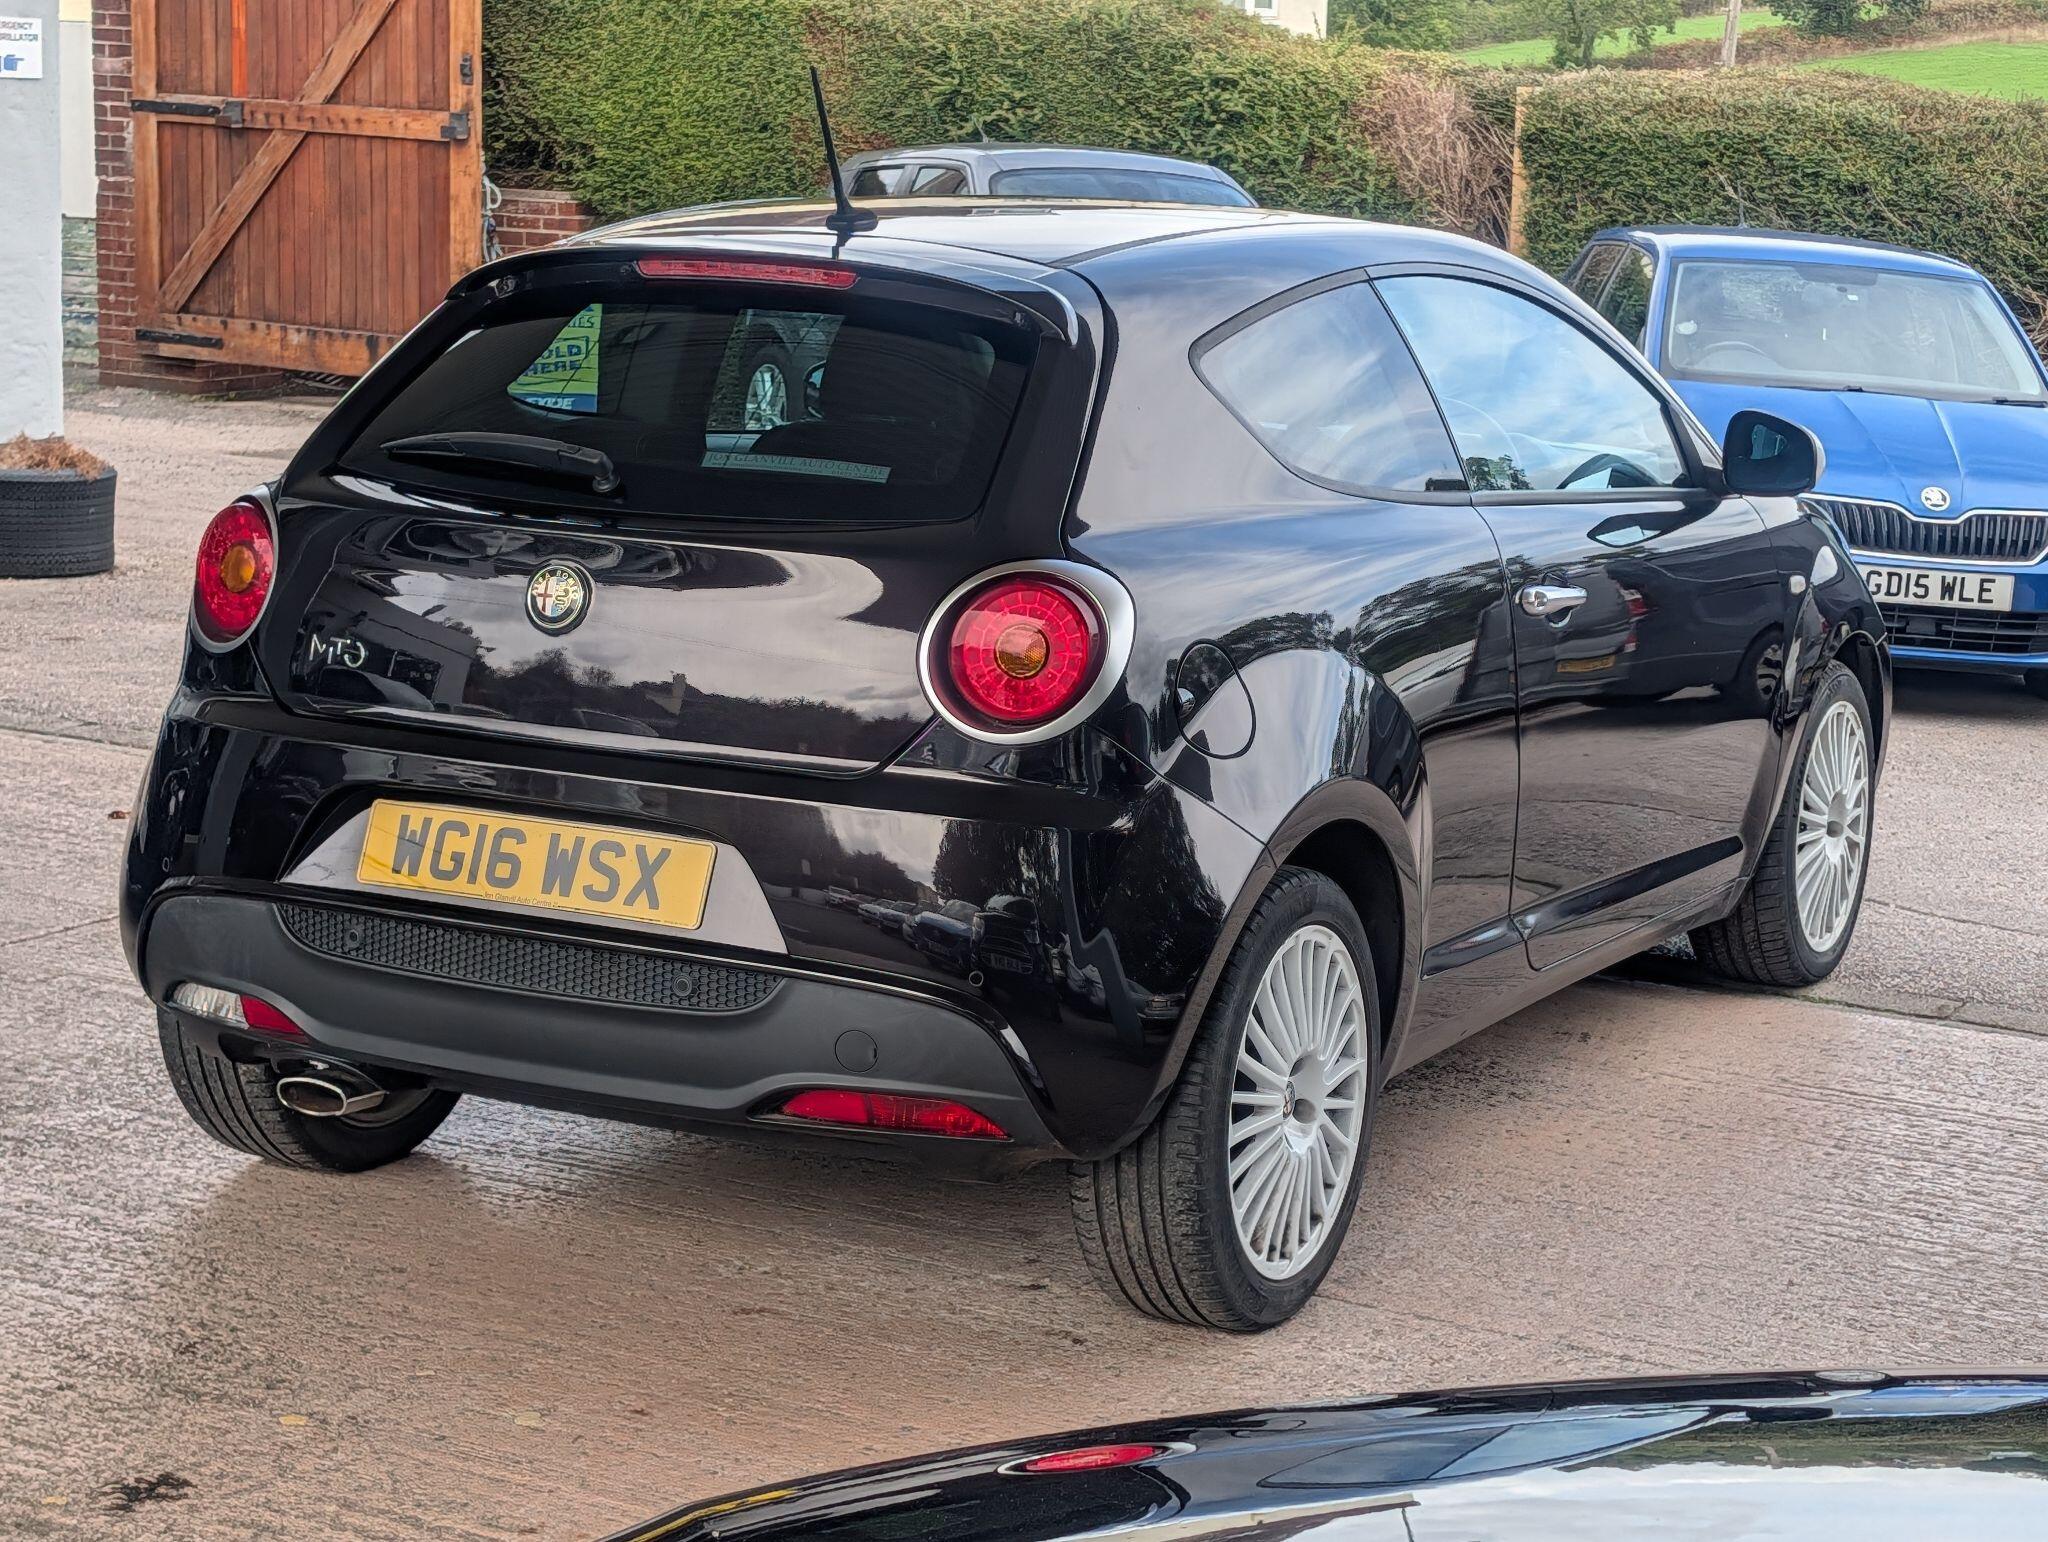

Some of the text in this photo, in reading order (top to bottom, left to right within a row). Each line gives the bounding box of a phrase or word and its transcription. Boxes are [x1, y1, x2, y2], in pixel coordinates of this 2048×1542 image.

[0, 21, 33, 30] RGENCY
[542, 344, 581, 359] OLD
[1866, 570, 1997, 604] GD15 WLE
[392, 814, 672, 910] WG16 WSX
